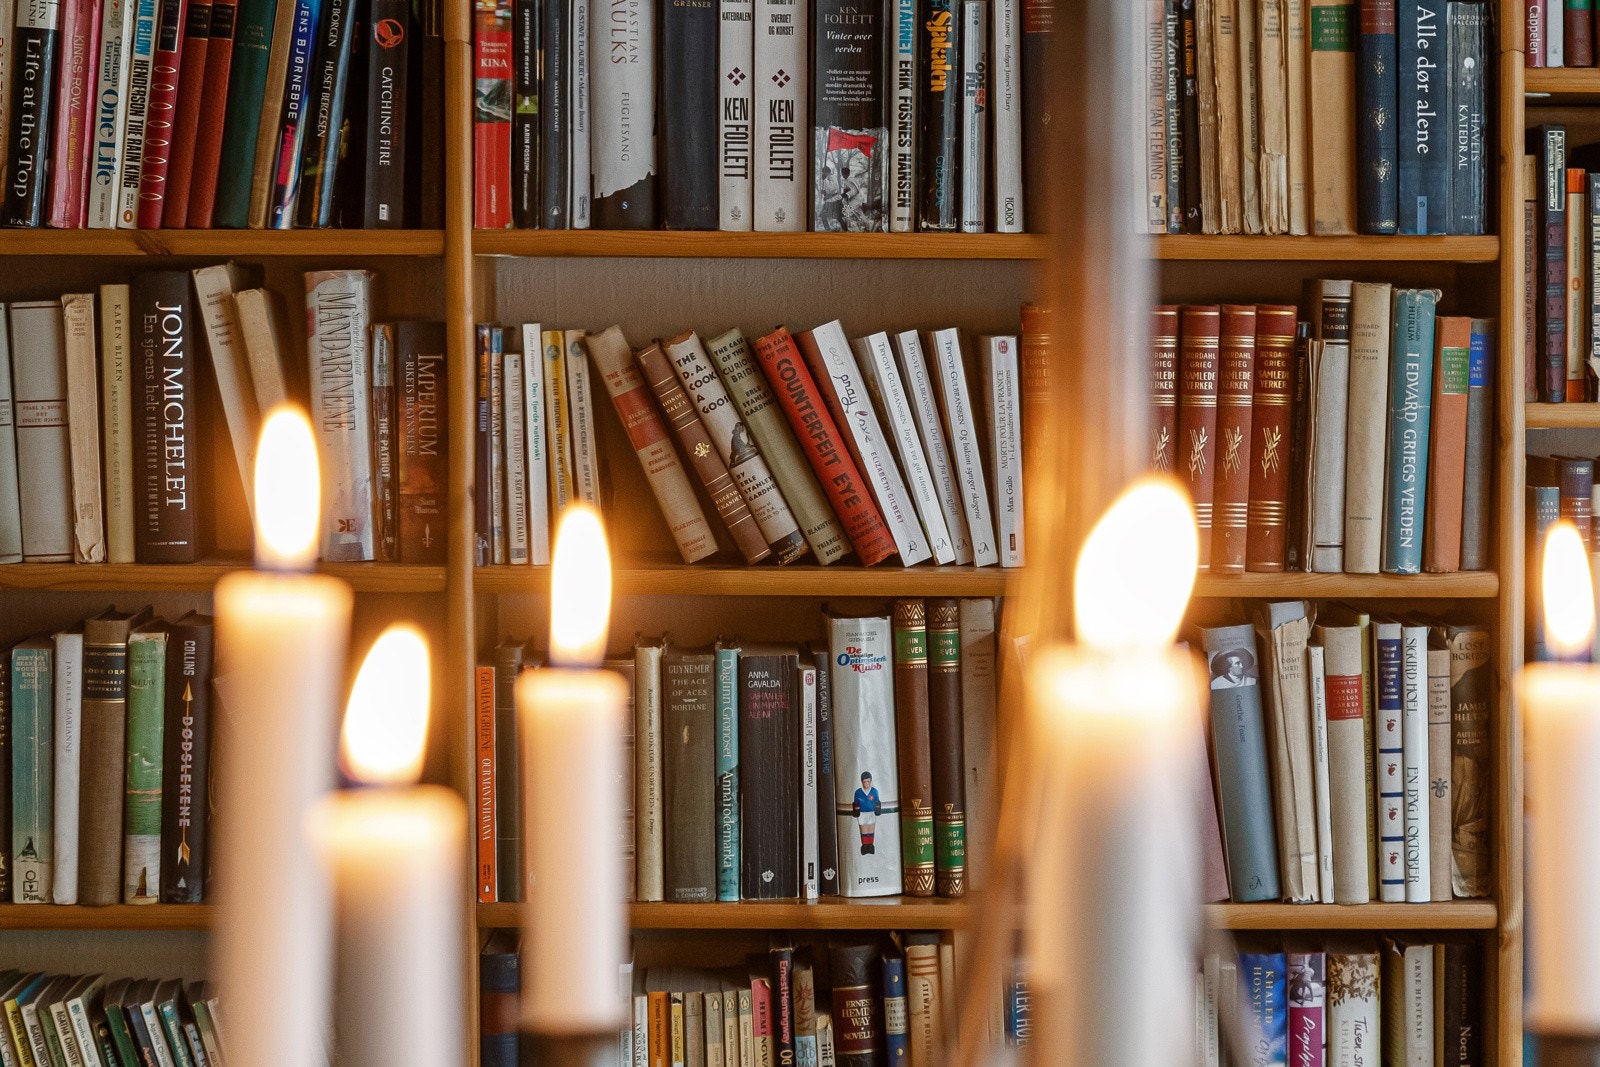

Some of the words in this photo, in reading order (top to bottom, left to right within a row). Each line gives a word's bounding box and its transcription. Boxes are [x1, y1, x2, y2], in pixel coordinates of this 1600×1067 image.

[298, 3, 309, 32] JENS
[578, 5, 586, 38] GUSTAVE
[722, 12, 752, 21] KATEDRALEN
[824, 14, 874, 25] FOLLETT
[839, 6, 858, 14] KEN
[1166, 12, 1179, 37] The
[327, 7, 341, 47] BORGEN
[768, 26, 775, 35] OG
[826, 31, 852, 40] Vinter
[1416, 5, 1436, 49] Alle
[1528, 5, 1540, 54] Cappelen
[24, 39, 41, 81] Life
[73, 34, 85, 73] KINGS
[481, 58, 508, 68] KINA
[578, 40, 586, 77] FLAUBERT
[835, 44, 862, 53] verden
[925, 10, 953, 92] Sjakalen
[1149, 20, 1163, 101] THUNDERBALL
[1167, 39, 1178, 65] Zoo
[129, 59, 149, 117] HENDERSON
[288, 39, 306, 120] BJØRNEBOE
[322, 61, 334, 90] HUSET
[898, 60, 913, 91] ERIK
[965, 72, 976, 97] FILE
[974, 61, 985, 114] ODESSA
[1167, 67, 1179, 101] Gang
[1416, 56, 1437, 93] dør
[22, 87, 37, 108] at
[70, 77, 81, 109] ROW
[380, 67, 393, 135] CATCHING
[724, 98, 749, 121] KEN
[1004, 93, 1012, 112] Diary
[100, 89, 118, 138] One
[316, 92, 331, 138] BERGESEN
[621, 92, 630, 162] FUGLESANG
[770, 99, 794, 123] KEN
[897, 96, 912, 148] FOSNES
[1169, 103, 1180, 134] Paul
[1416, 100, 1437, 154] alene
[19, 113, 35, 149] the
[128, 119, 143, 137] THE
[1471, 113, 1480, 161] HAVETS
[96, 141, 117, 186] Life
[125, 138, 141, 163] RAIN
[379, 139, 390, 166] FIRE
[724, 124, 748, 180] FOLLETT
[769, 126, 794, 182] FOLLETT
[1150, 132, 1163, 180] FLEMING
[1169, 137, 1181, 183] Gallico
[14, 155, 32, 197] Top
[123, 165, 139, 188] KING
[897, 153, 912, 208] HANSEN
[1005, 197, 1014, 226] PICADOR
[114, 304, 122, 339] KAREN
[143, 314, 157, 334] En
[155, 301, 183, 357] JON
[1407, 305, 1417, 342] HURUM
[115, 345, 123, 382] BLIXEN
[141, 338, 157, 380] sjøens
[317, 290, 358, 432] MANDARINENE
[675, 352, 697, 367] THE
[714, 348, 727, 357] THE
[729, 337, 744, 348] CASE
[722, 355, 731, 363] OF
[732, 347, 745, 357] THE
[944, 340, 954, 370] TRYGVE
[405, 361, 414, 394] RIKETS
[531, 382, 540, 399] Den
[833, 374, 858, 414] pray
[907, 341, 921, 370] TRYGVE
[915, 371, 934, 424] GULBRANSSEN
[997, 369, 1005, 403] FRANCE
[1404, 363, 1419, 423] EDVARD
[146, 384, 159, 411] helt
[416, 353, 443, 457] IMPERIUM
[531, 400, 540, 423] fjerde
[696, 394, 705, 403] A
[949, 371, 965, 425] GULBRANSSEN
[998, 405, 1006, 415] LA
[379, 417, 389, 436] THE
[406, 396, 415, 456] BEGYNNELSE
[492, 413, 500, 437] MAN
[512, 415, 520, 425] OF
[776, 357, 842, 467] COUNTERFEIT
[833, 473, 861, 508] EYE
[877, 341, 891, 370] TRYGVE
[886, 372, 908, 425] GULBRANSSEN
[903, 428, 916, 449] Ingen
[915, 476, 931, 502] utenom
[959, 429, 970, 441] Og
[999, 415, 1007, 439] POUR
[162, 367, 186, 511] MICHELET
[532, 425, 541, 460] nattevakt
[961, 442, 972, 465] bakom
[1000, 440, 1008, 469] MORTS
[1402, 429, 1417, 482] GRIEGS
[380, 440, 390, 479] PATRIOT
[514, 479, 523, 500] SCOTT
[742, 476, 774, 495] STANLEY
[870, 451, 891, 492] ELIZABETH
[886, 493, 904, 524] GILBERT
[1005, 475, 1014, 495] Gallo
[970, 493, 983, 520] skogene
[1007, 496, 1015, 513] Max
[1399, 487, 1415, 548] VERDEN
[183, 640, 195, 676] COLLINS
[846, 647, 862, 655] De
[1405, 638, 1419, 680] SIGURD
[65, 660, 73, 677] JAN
[668, 664, 710, 674] GUYNEMER
[748, 671, 769, 679] ANNA
[748, 680, 781, 688] GAVALDA
[852, 663, 882, 673] Klubb
[480, 672, 491, 713] GRAHAM
[1235, 694, 1244, 722] Goethe
[1406, 683, 1419, 716] HOEL
[65, 707, 73, 754] MARIANNE
[805, 729, 813, 737] Je
[178, 716, 194, 827] DØDSLEKENE
[482, 758, 491, 776] OUR
[806, 768, 814, 788] Anna
[1406, 766, 1418, 784] EN
[722, 770, 734, 802] Anna
[1406, 789, 1419, 813] DAG
[482, 807, 491, 841] HAVANA
[1406, 826, 1419, 883] OKTOBER
[780, 960, 788, 992] Ernest
[922, 983, 930, 1019] STEWART
[1265, 970, 1274, 1024] KHALED
[57, 1011, 69, 1036] AGATHA
[780, 991, 790, 1044] Hemingway
[851, 1017, 871, 1026] WAY
[1460, 1026, 1471, 1060] Noen
